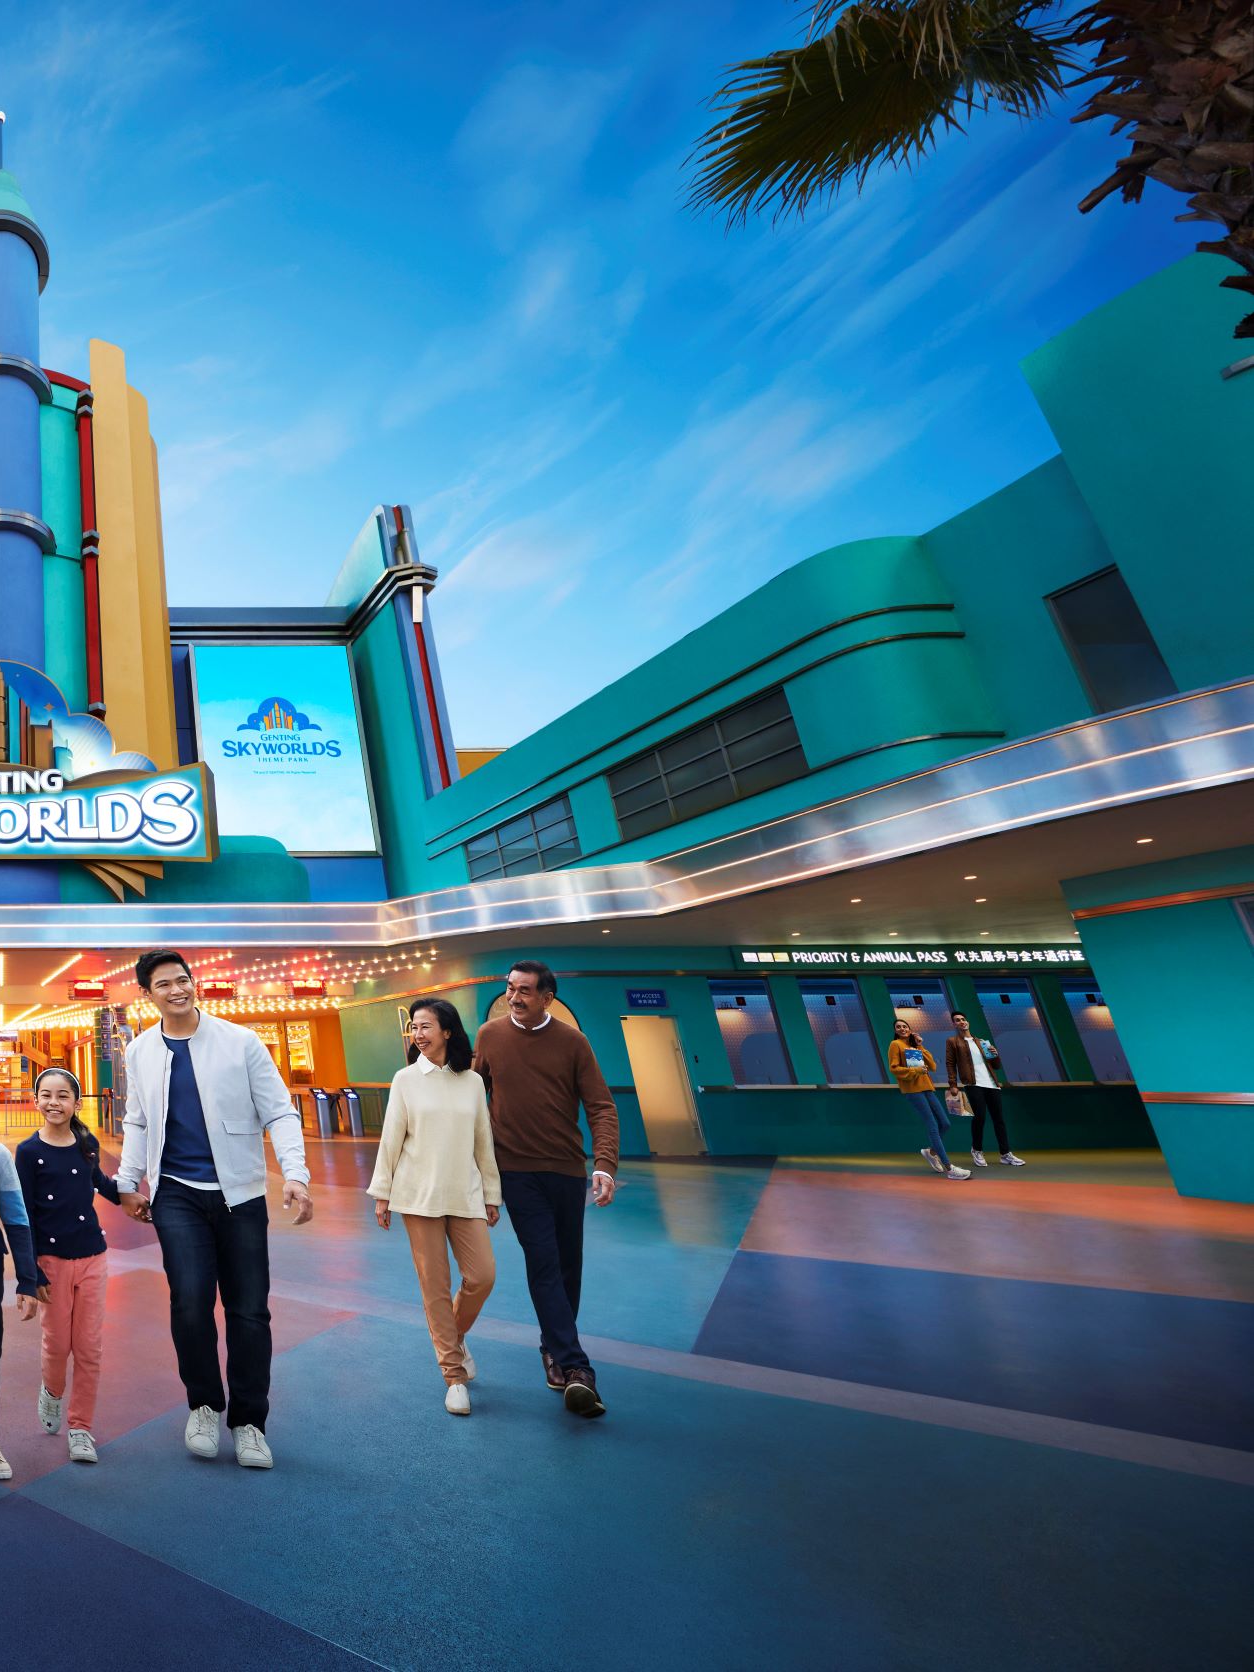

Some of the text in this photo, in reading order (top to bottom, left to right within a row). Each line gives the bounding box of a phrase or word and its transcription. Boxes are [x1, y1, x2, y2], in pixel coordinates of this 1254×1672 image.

[260, 733, 301, 742] GENTING
[221, 740, 342, 758] SKYWORLDS
[791, 951, 948, 963] PRIORITY & ANNUAL PASS
